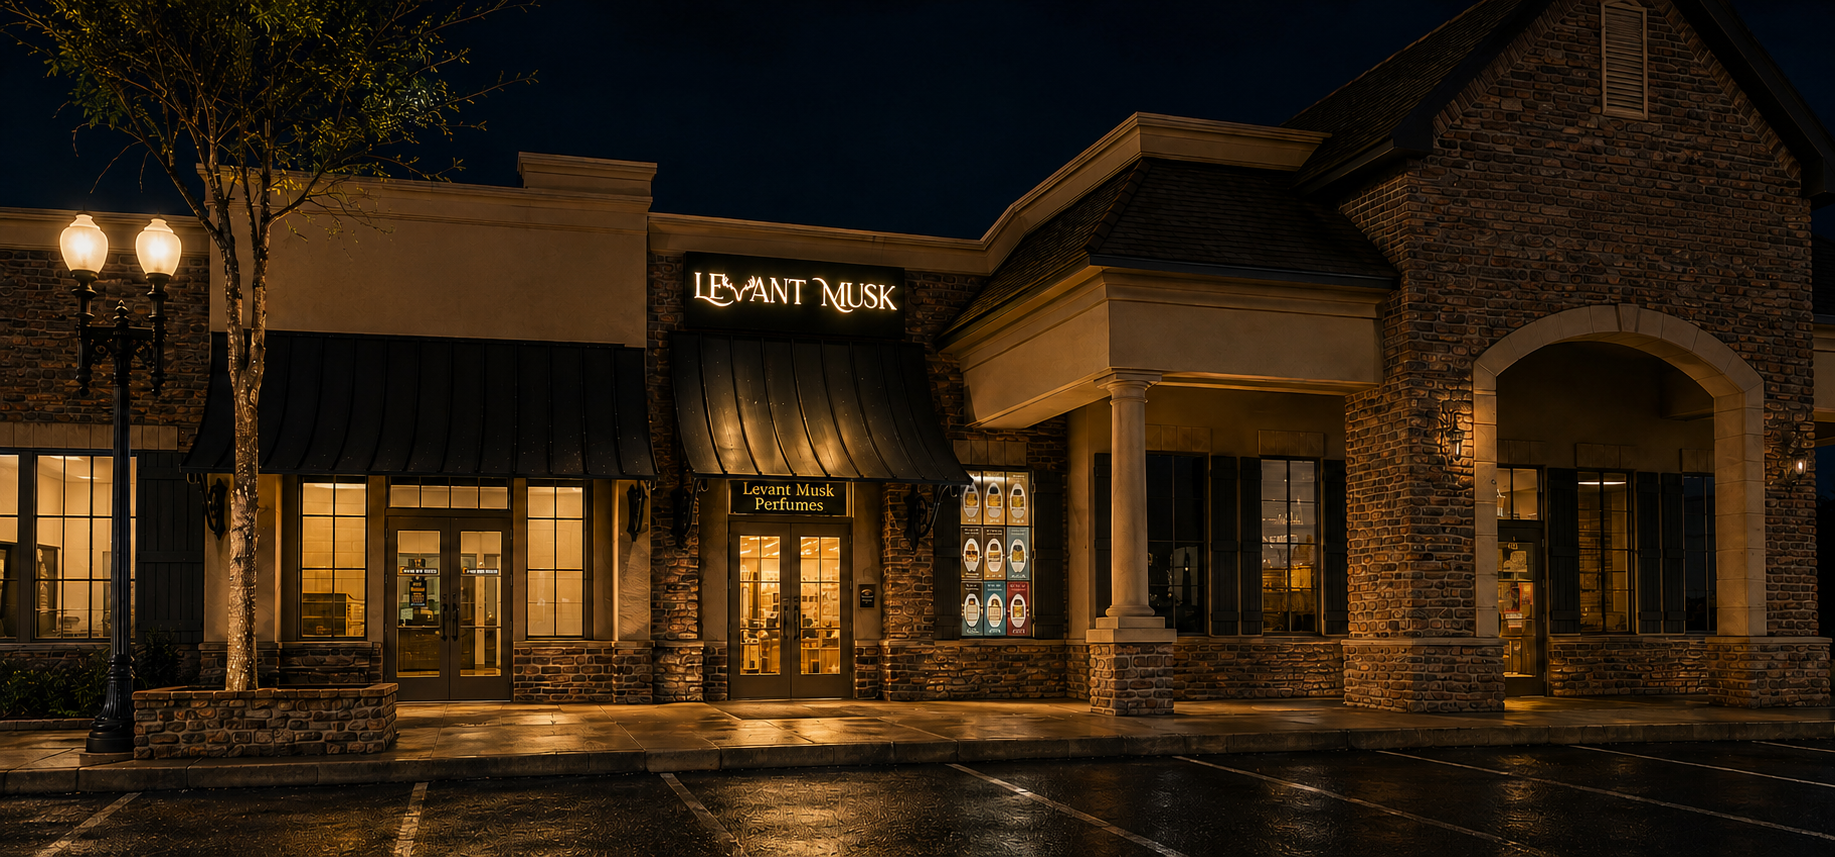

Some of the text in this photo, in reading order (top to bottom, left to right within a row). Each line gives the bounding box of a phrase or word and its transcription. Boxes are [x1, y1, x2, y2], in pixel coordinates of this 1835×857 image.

[694, 272, 897, 313] LEVANT MUSK
[743, 481, 835, 497] Levant Musk
[755, 497, 824, 511] Perfumes
